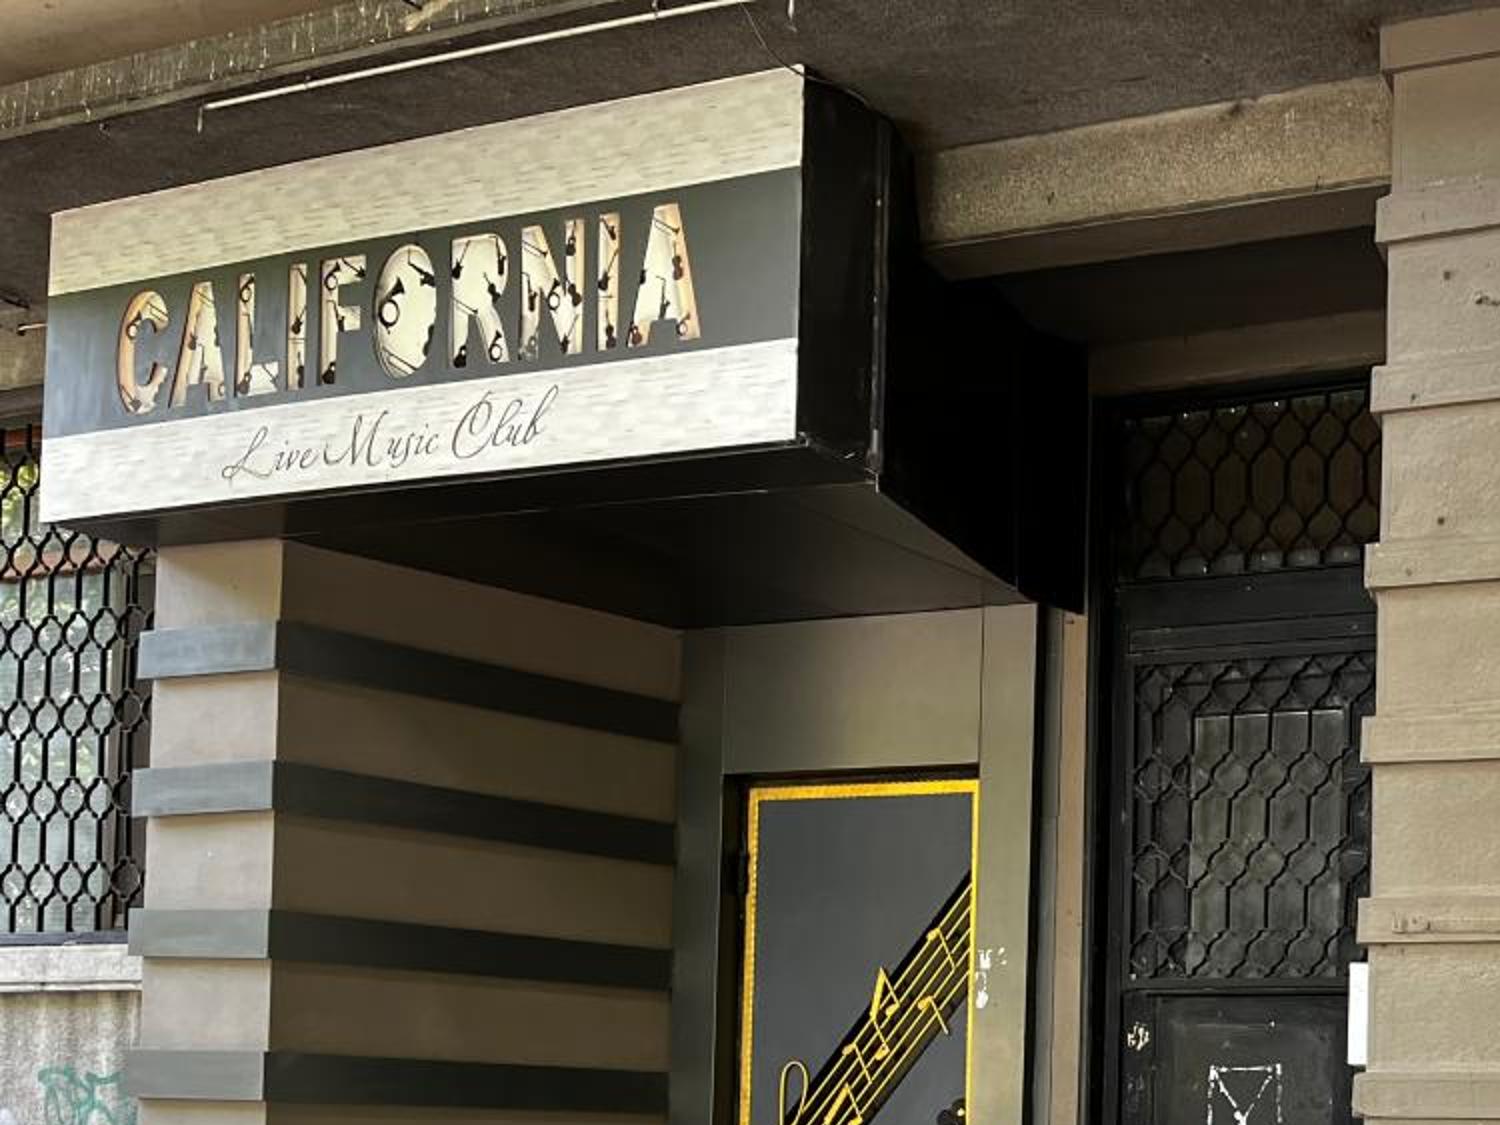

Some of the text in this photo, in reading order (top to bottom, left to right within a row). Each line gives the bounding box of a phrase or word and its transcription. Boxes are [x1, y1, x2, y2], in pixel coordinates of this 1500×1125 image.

[116, 202, 701, 415] CALIFORNIA
[221, 385, 559, 480] Live Music Club
